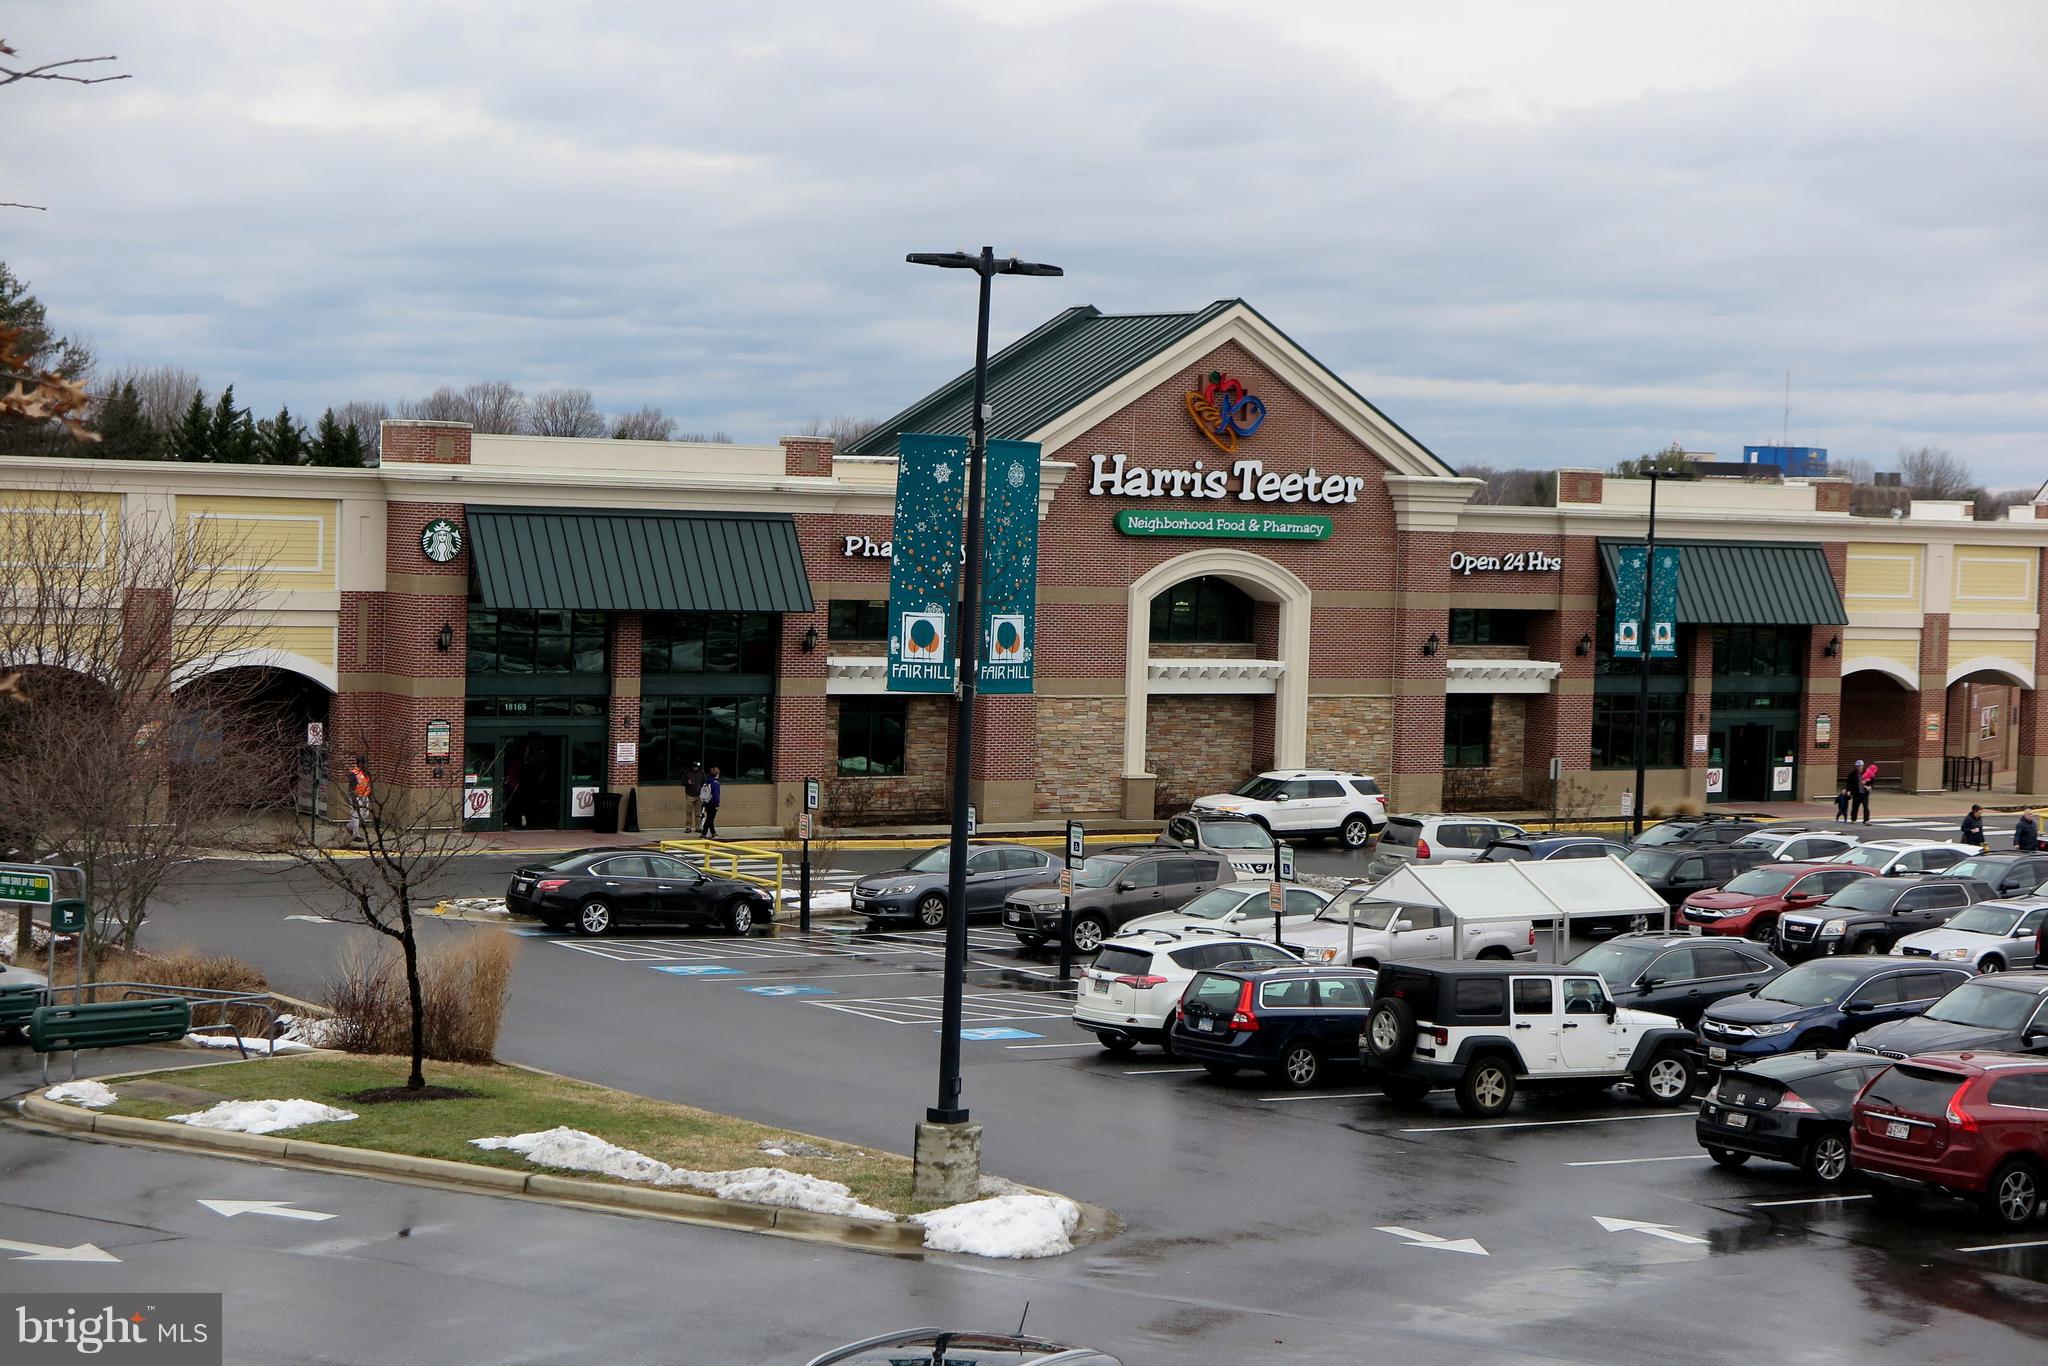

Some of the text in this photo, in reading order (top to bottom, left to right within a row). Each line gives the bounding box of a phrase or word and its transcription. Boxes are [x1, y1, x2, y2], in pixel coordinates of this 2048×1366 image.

[1089, 453, 1365, 504] Harris Teeter
[1127, 516, 1325, 537] Neighborhood Food & Pharmacy
[1450, 551, 1561, 575] Open 24 Hrs
[892, 663, 952, 680] FAIR HILL
[980, 665, 1030, 680] FAIR HILL
[504, 703, 527, 711] 18169
